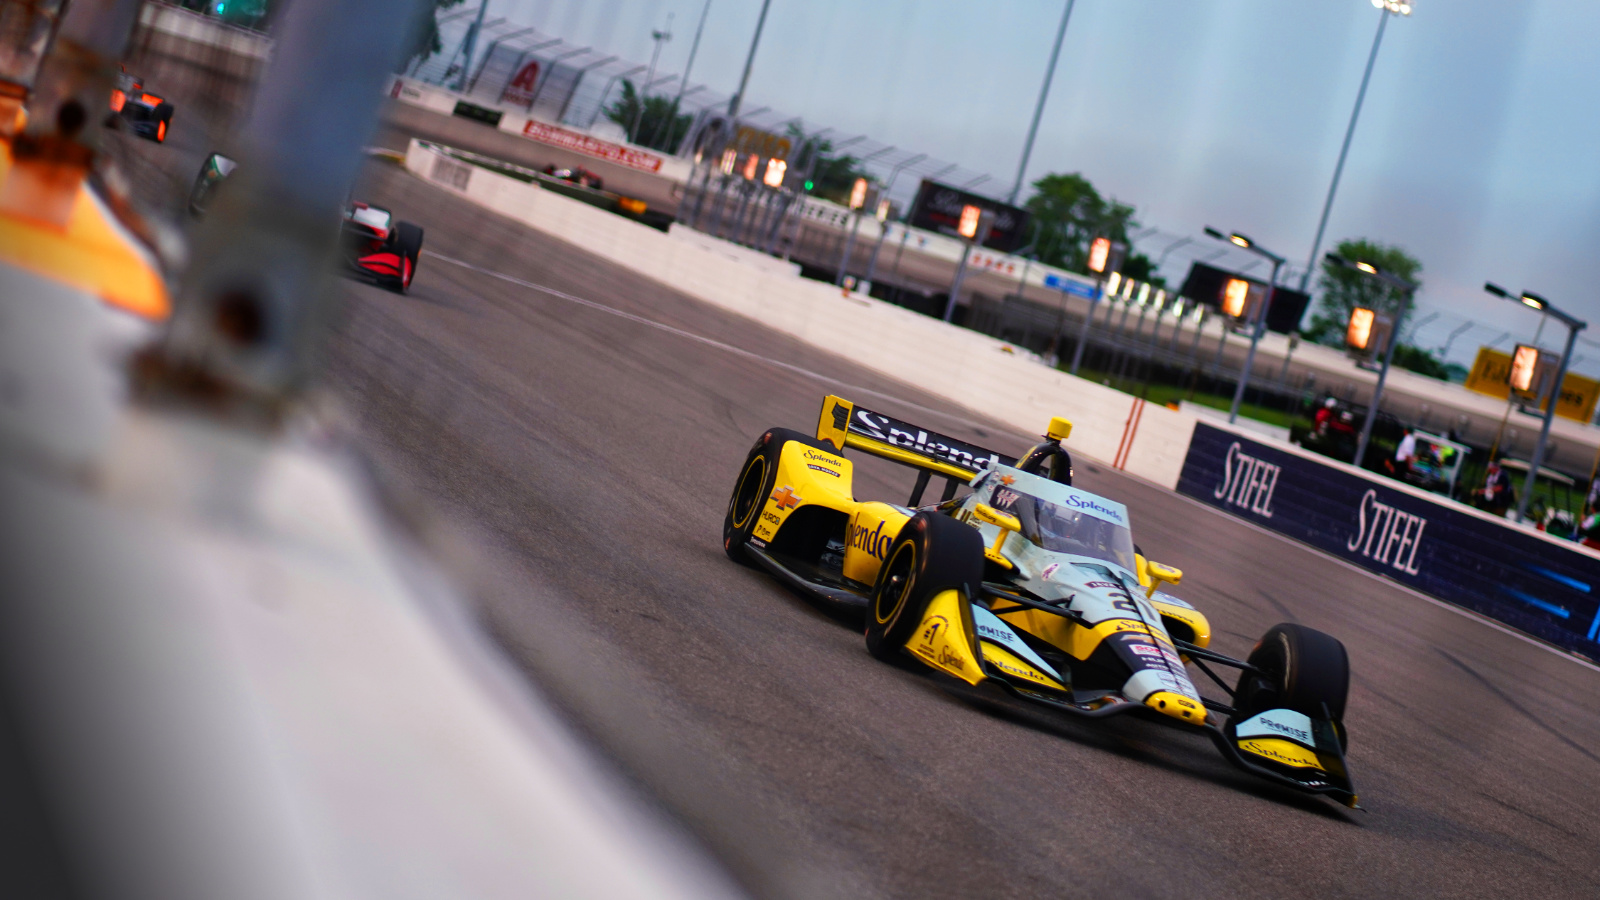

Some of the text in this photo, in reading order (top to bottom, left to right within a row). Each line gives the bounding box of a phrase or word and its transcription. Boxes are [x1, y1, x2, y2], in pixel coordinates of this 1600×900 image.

[848, 410, 1000, 471] Splend
[803, 449, 842, 468] Splenda
[1214, 441, 1282, 518] STIFEL
[762, 510, 781, 526] HURCO
[1065, 494, 1123, 523] Splenda
[1347, 488, 1428, 577] STIFEL
[1259, 716, 1309, 741] PROMISE
